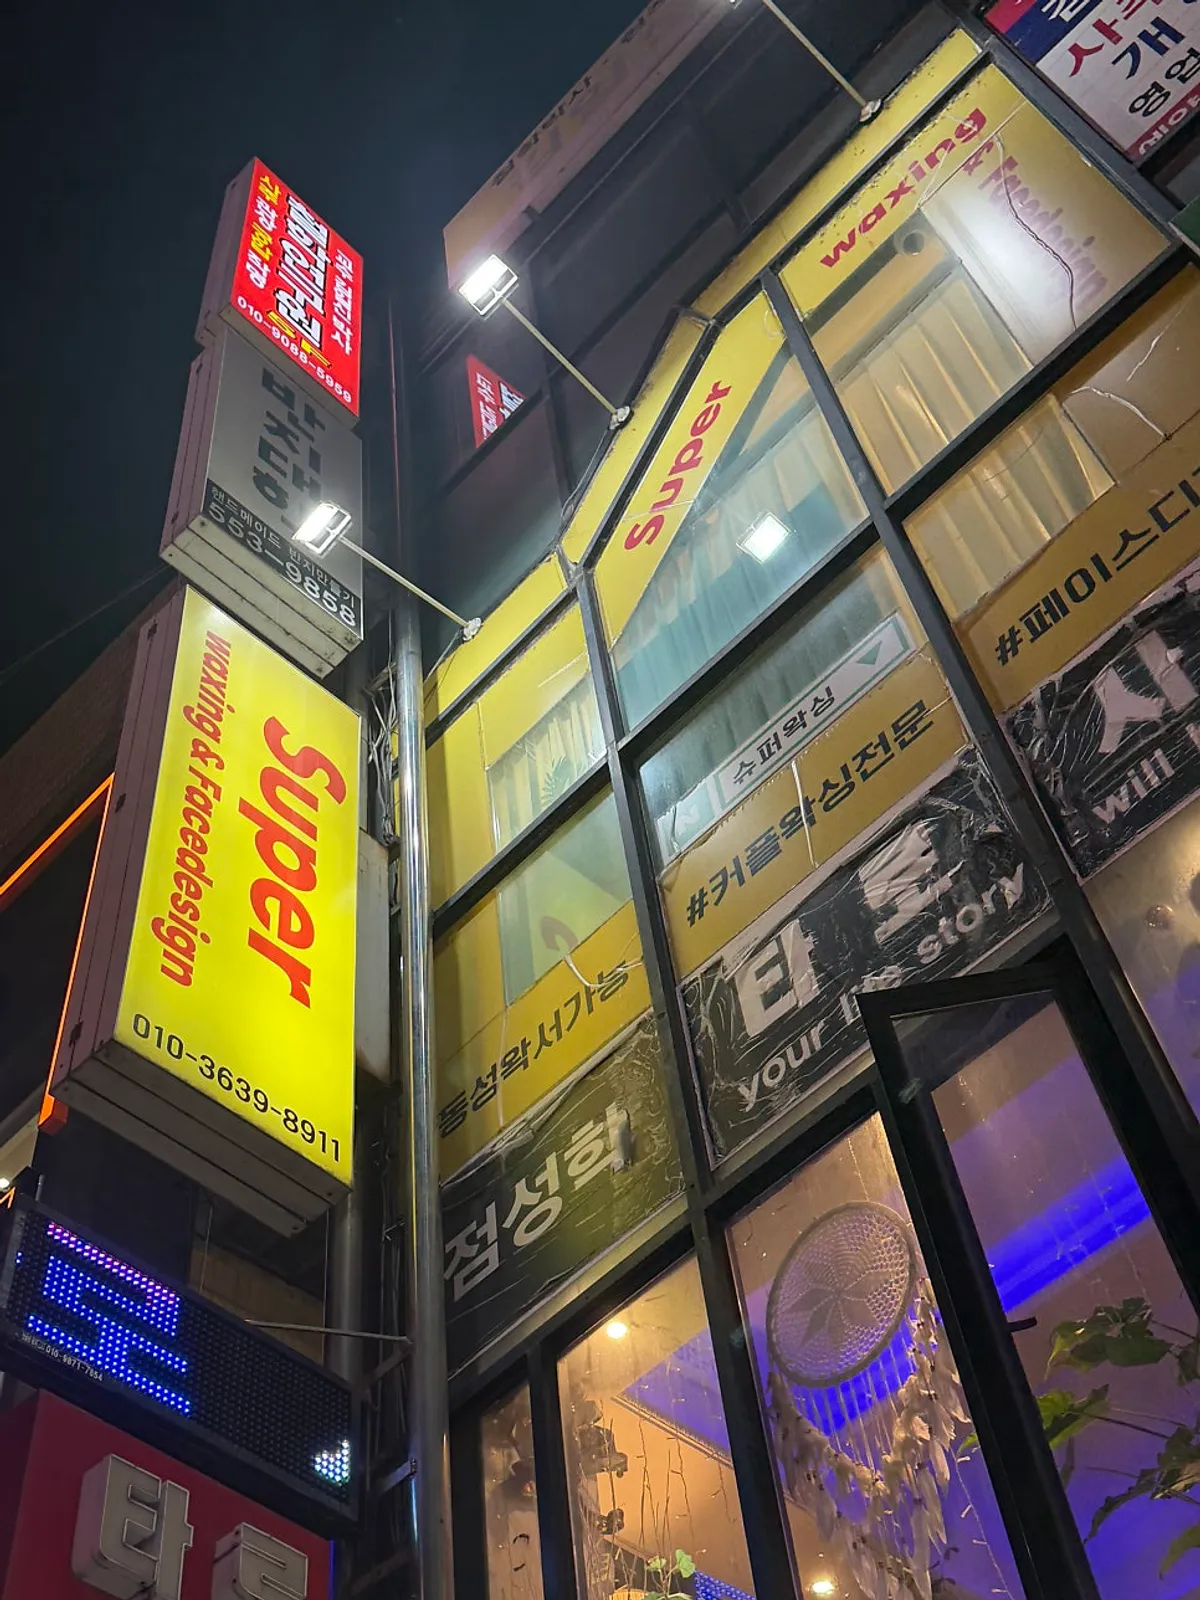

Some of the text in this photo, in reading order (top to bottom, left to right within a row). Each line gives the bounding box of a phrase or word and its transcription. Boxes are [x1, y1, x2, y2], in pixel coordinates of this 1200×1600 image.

[820, 108, 987, 268] waxing
[237, 295, 353, 404] 010-9088-5959
[274, 193, 333, 349] 철학연구원
[624, 380, 732, 551] Super
[208, 501, 357, 628] 553-9858
[995, 466, 1200, 667] #페이스디
[150, 629, 235, 989] waxing & Facedesign
[687, 699, 935, 927] #커플왁싱전문
[732, 685, 836, 786] 수퍼왁싱
[1093, 748, 1175, 825] will
[238, 714, 348, 1010] Super
[736, 1020, 827, 1113] your
[916, 860, 1026, 964] story
[131, 1012, 342, 1165] 010-3639-8911
